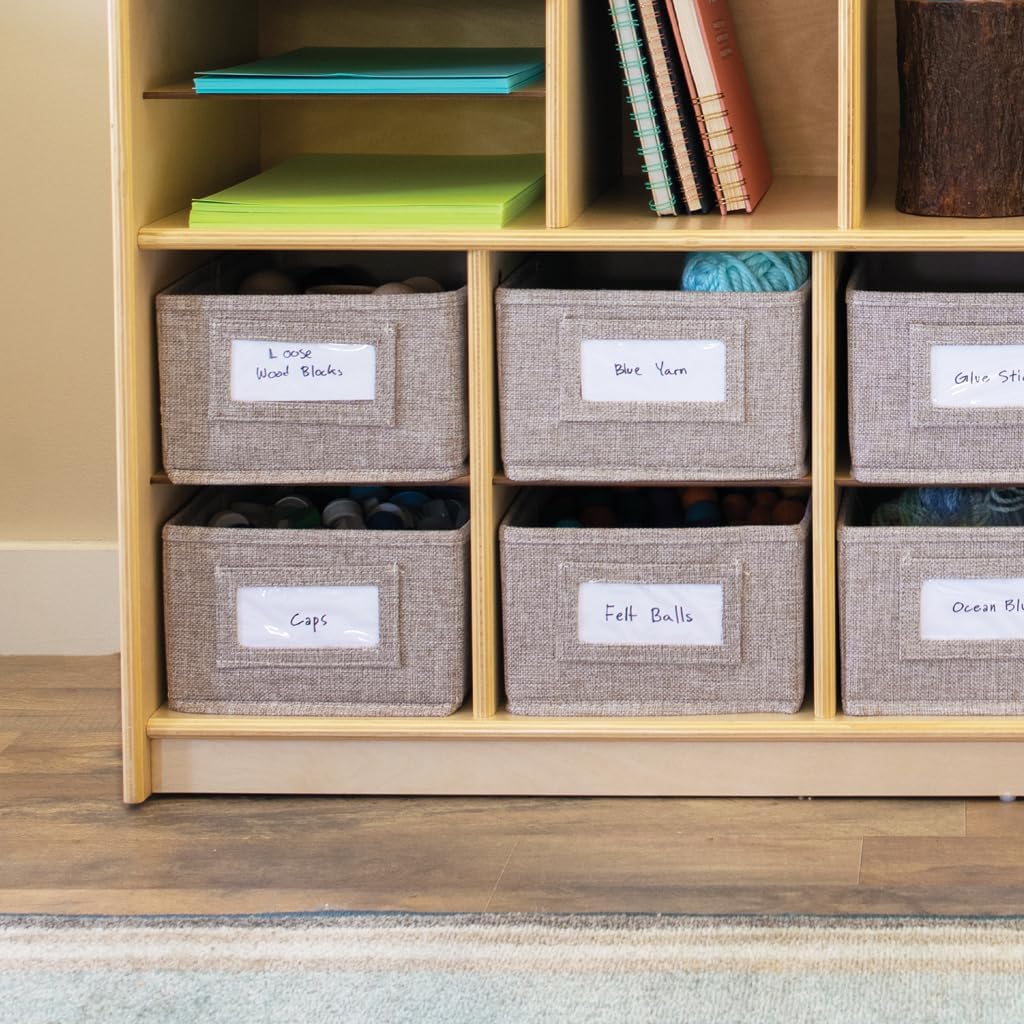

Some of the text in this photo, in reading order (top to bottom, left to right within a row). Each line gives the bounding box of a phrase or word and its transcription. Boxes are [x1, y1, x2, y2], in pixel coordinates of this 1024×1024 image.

[267, 347, 313, 360] Loose
[256, 364, 344, 380] Wood Blocks
[614, 361, 688, 377] Blue Yarn
[954, 371, 989, 385] Glue
[604, 603, 694, 625] Felt Balls
[951, 600, 997, 614] Ocean
[289, 612, 328, 634] Caps
